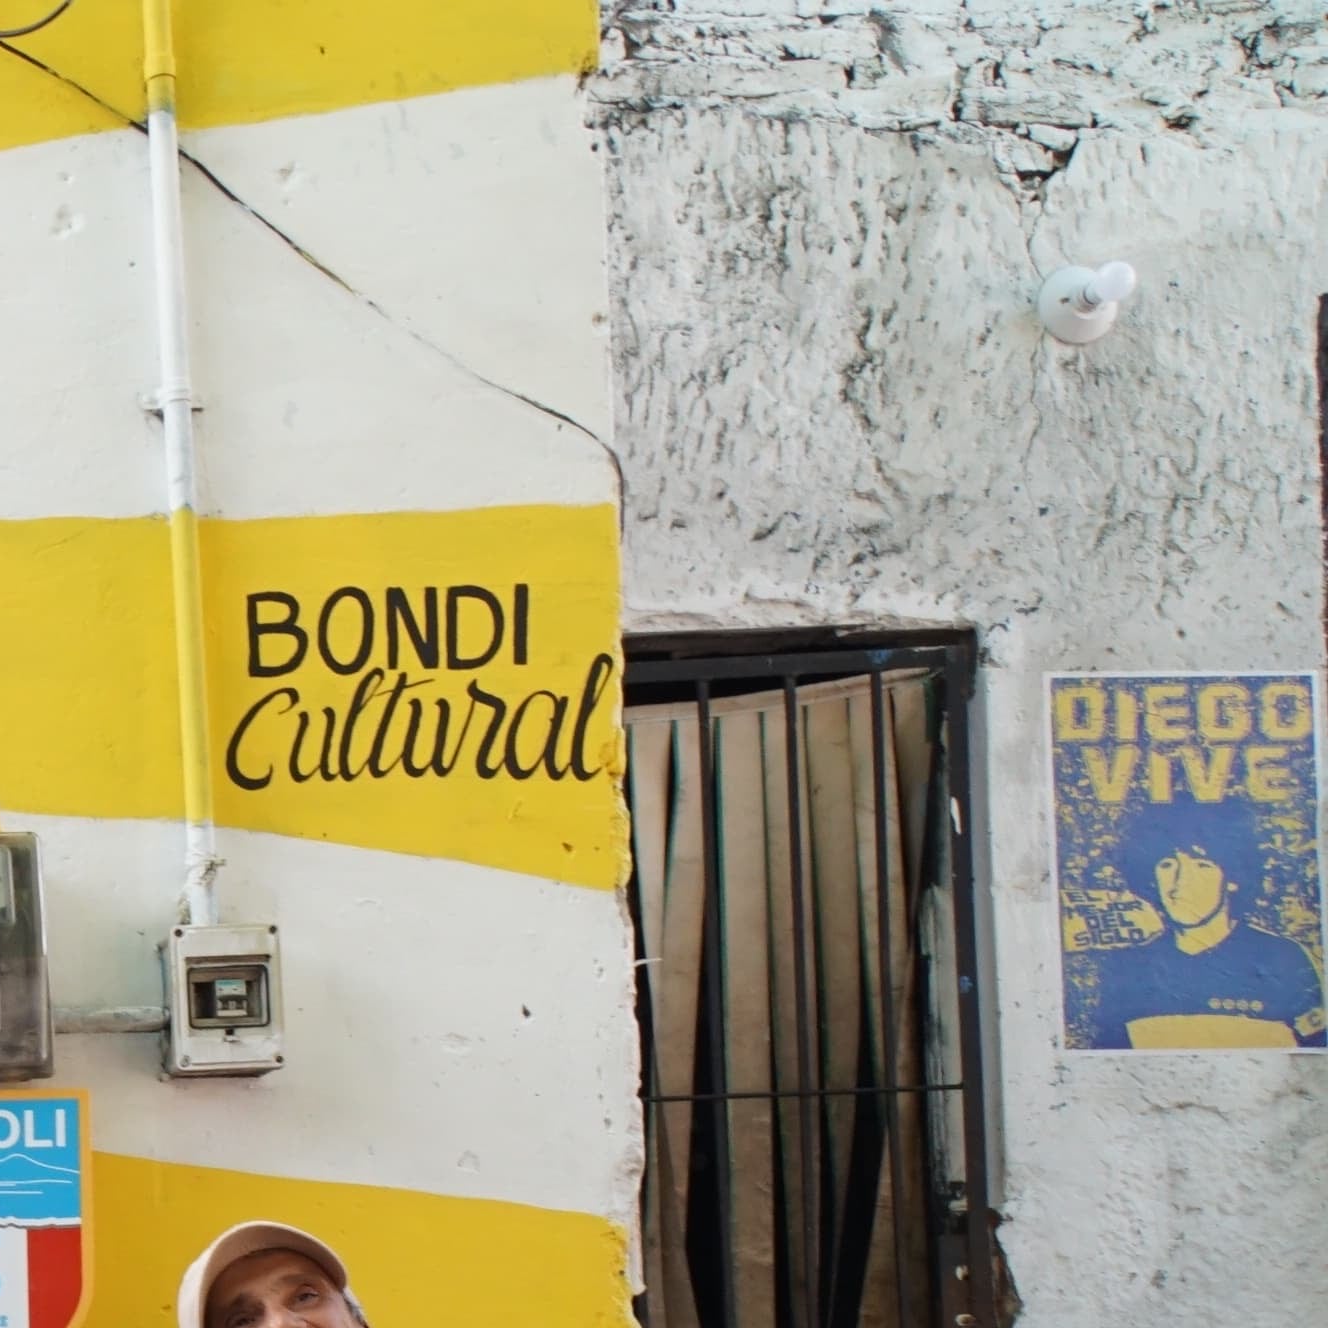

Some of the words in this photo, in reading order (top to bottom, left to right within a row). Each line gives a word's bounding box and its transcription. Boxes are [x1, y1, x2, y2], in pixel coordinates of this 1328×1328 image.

[245, 582, 531, 679] BONDI
[224, 652, 616, 792] Cultural
[1053, 682, 1314, 743] DIEGO
[1080, 744, 1294, 804] VIVE
